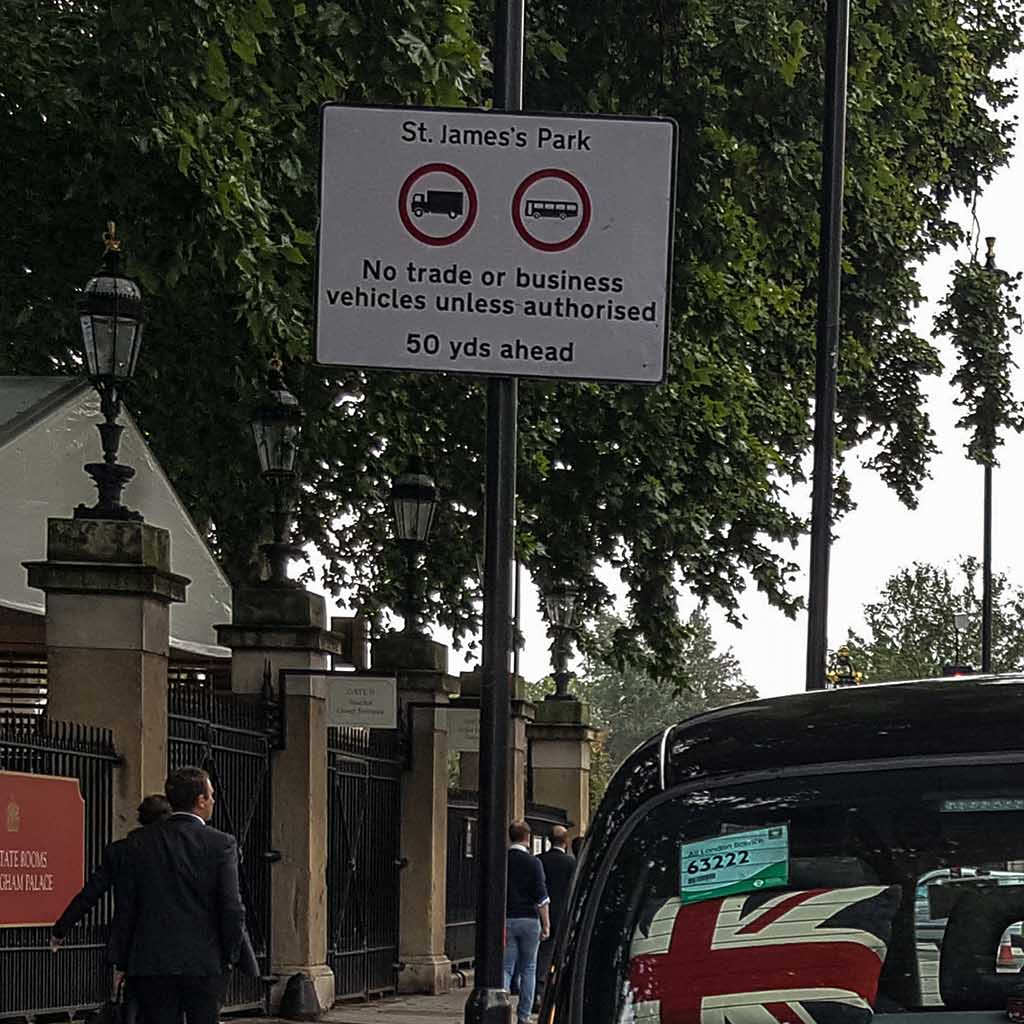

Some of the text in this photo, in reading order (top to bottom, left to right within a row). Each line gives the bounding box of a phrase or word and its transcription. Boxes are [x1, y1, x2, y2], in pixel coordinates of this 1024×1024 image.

[402, 121, 591, 151] St. James's Park
[363, 260, 623, 292] No trade or business
[327, 288, 656, 322] vehicles unless authorised
[406, 334, 574, 362] 50 yds ahead
[21, 850, 48, 868] ROOMS
[687, 850, 749, 874] 63222
[26, 873, 53, 890] PALACE
